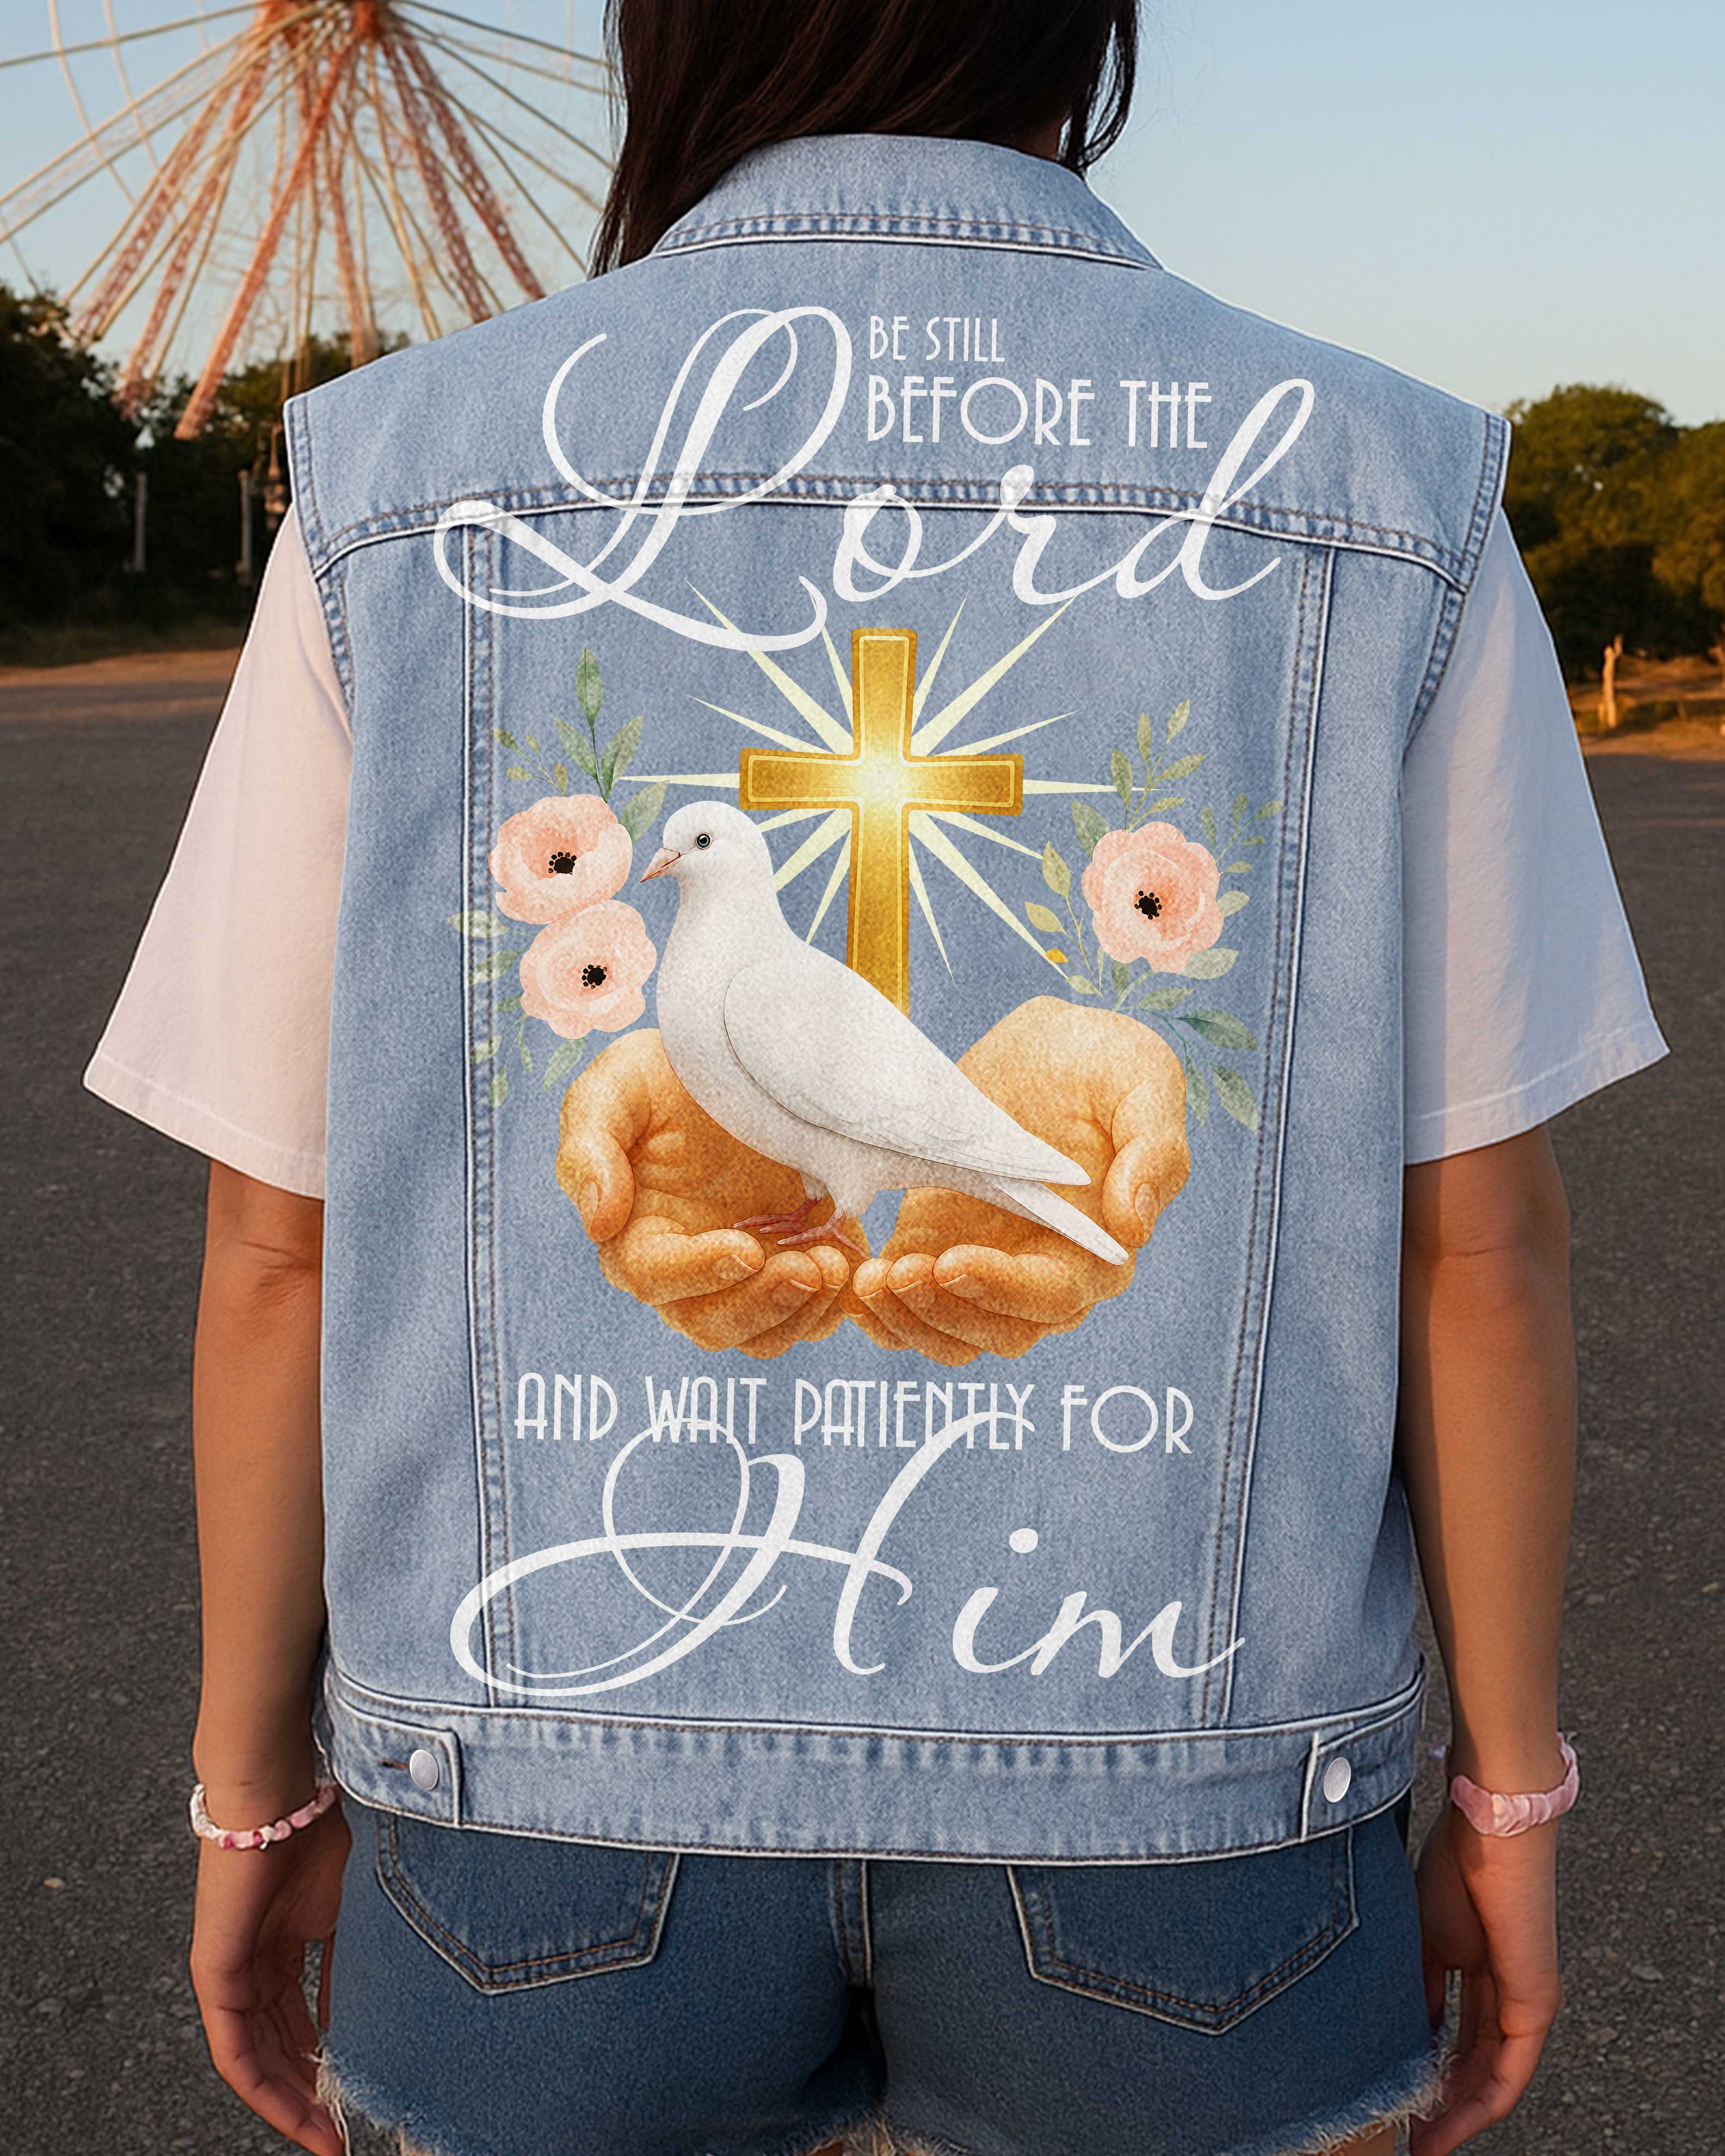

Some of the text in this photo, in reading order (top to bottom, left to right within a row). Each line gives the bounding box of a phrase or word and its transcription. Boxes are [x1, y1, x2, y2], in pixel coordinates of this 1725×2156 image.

[869, 315, 1006, 363] BE STILL
[868, 375, 1213, 449] BEFORE THE
[433, 305, 1316, 652] Lord
[514, 1371, 1195, 1454] AND WAIT PATIENTLY FOR
[450, 1411, 1246, 1696] Him
